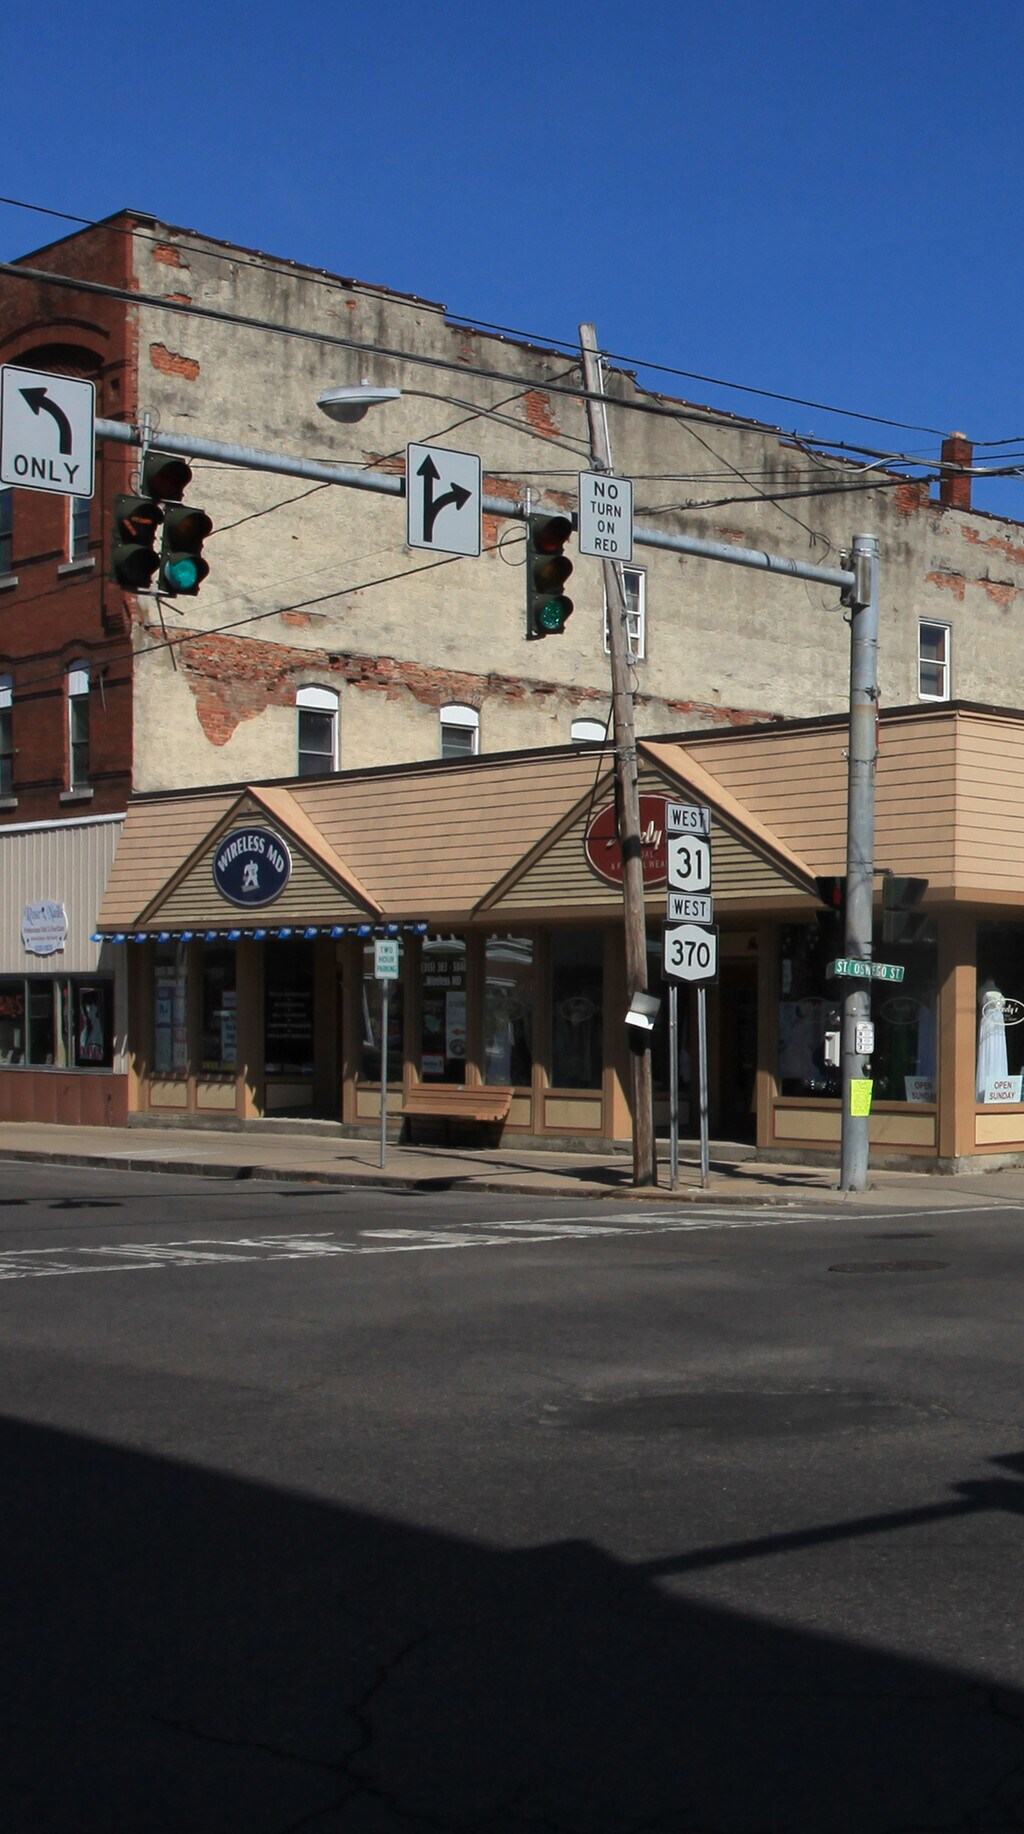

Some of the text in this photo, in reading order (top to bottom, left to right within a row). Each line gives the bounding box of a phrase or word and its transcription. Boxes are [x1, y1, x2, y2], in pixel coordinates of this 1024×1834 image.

[14, 454, 80, 485] ONLY
[594, 481, 618, 499] NO
[590, 500, 622, 518] TURN
[597, 520, 615, 535] ON
[594, 537, 618, 553] RED
[672, 809, 705, 828] WEST
[217, 835, 286, 873] WIRELESS MD
[649, 860, 667, 869] WEA
[676, 847, 703, 880] 31
[674, 899, 707, 917] WEST
[380, 946, 392, 954] TWO
[671, 939, 710, 968] 370
[378, 955, 395, 964] HOUR
[376, 965, 397, 973] PARKING
[854, 962, 901, 979] OSWEGO ST
[994, 1081, 1012, 1089] OPEN
[989, 1092, 1016, 1100] SUNDAY
